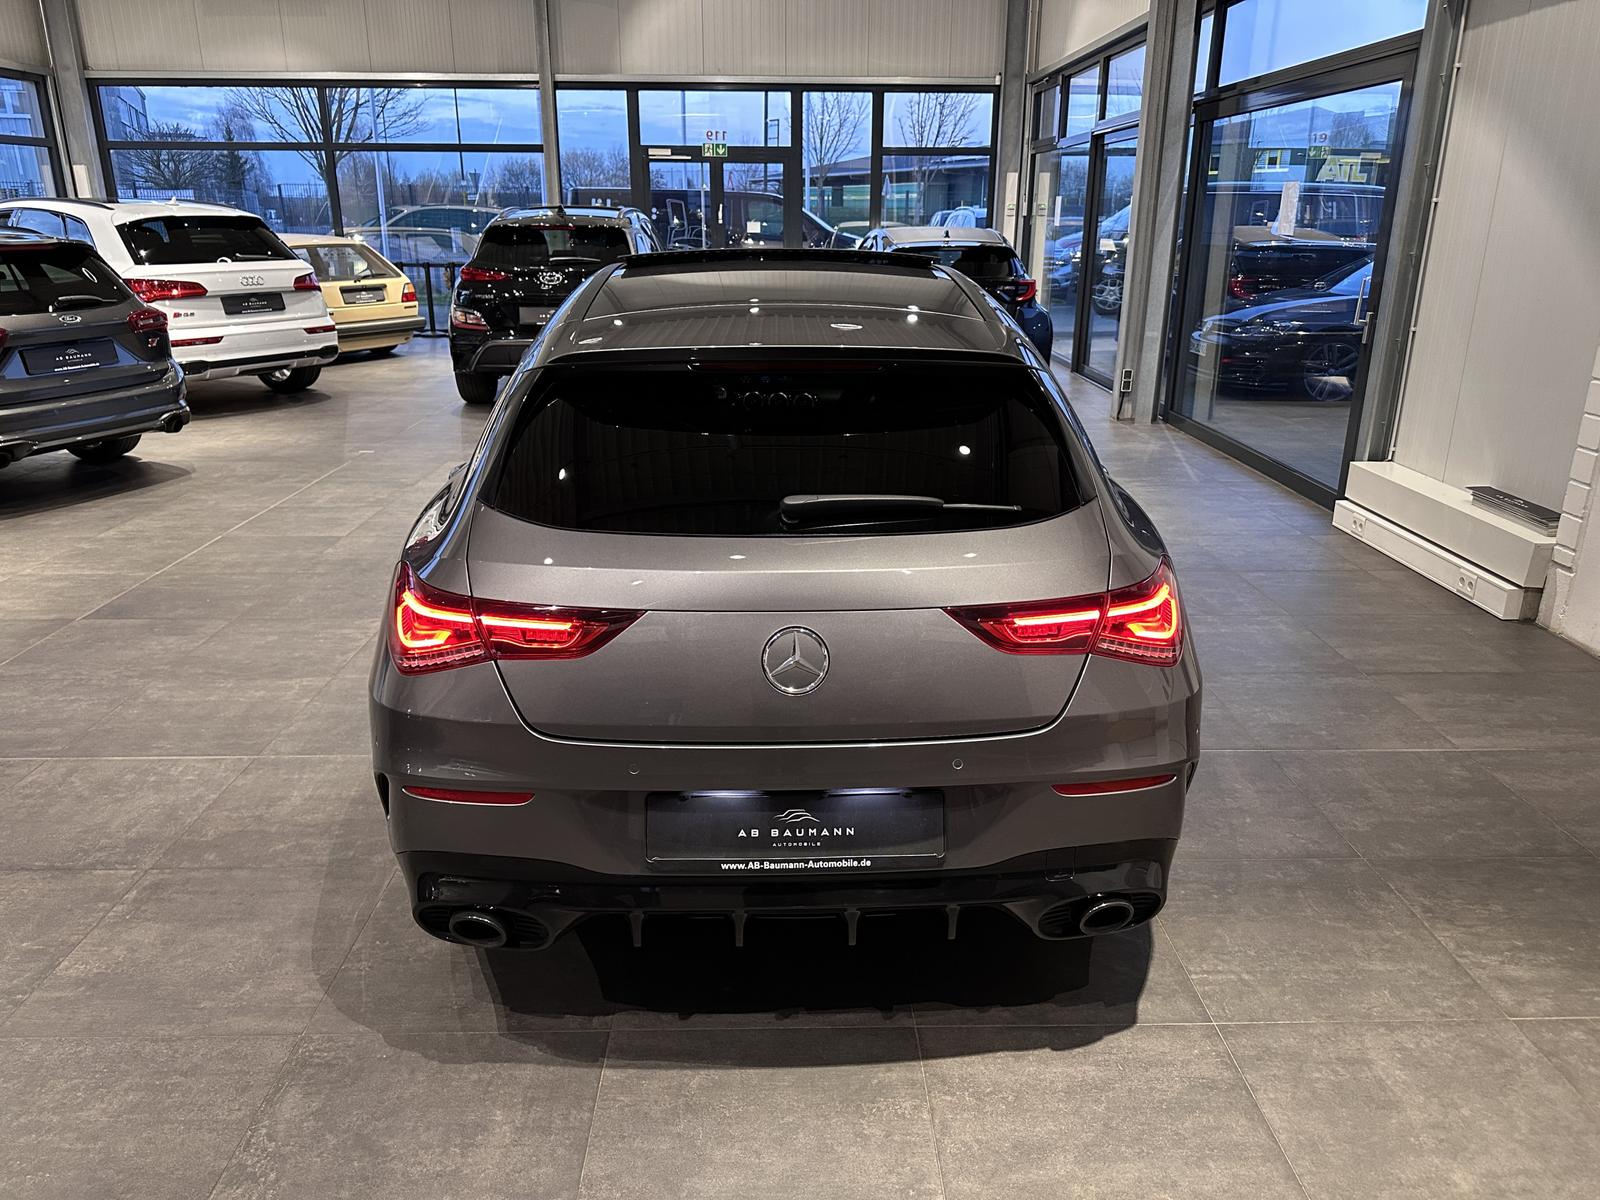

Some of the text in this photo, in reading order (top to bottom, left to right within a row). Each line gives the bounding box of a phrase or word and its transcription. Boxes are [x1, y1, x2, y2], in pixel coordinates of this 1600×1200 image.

[737, 827, 855, 837] AB BAUMANN
[720, 859, 872, 870] www.AB-Baumann-Automobile.de
